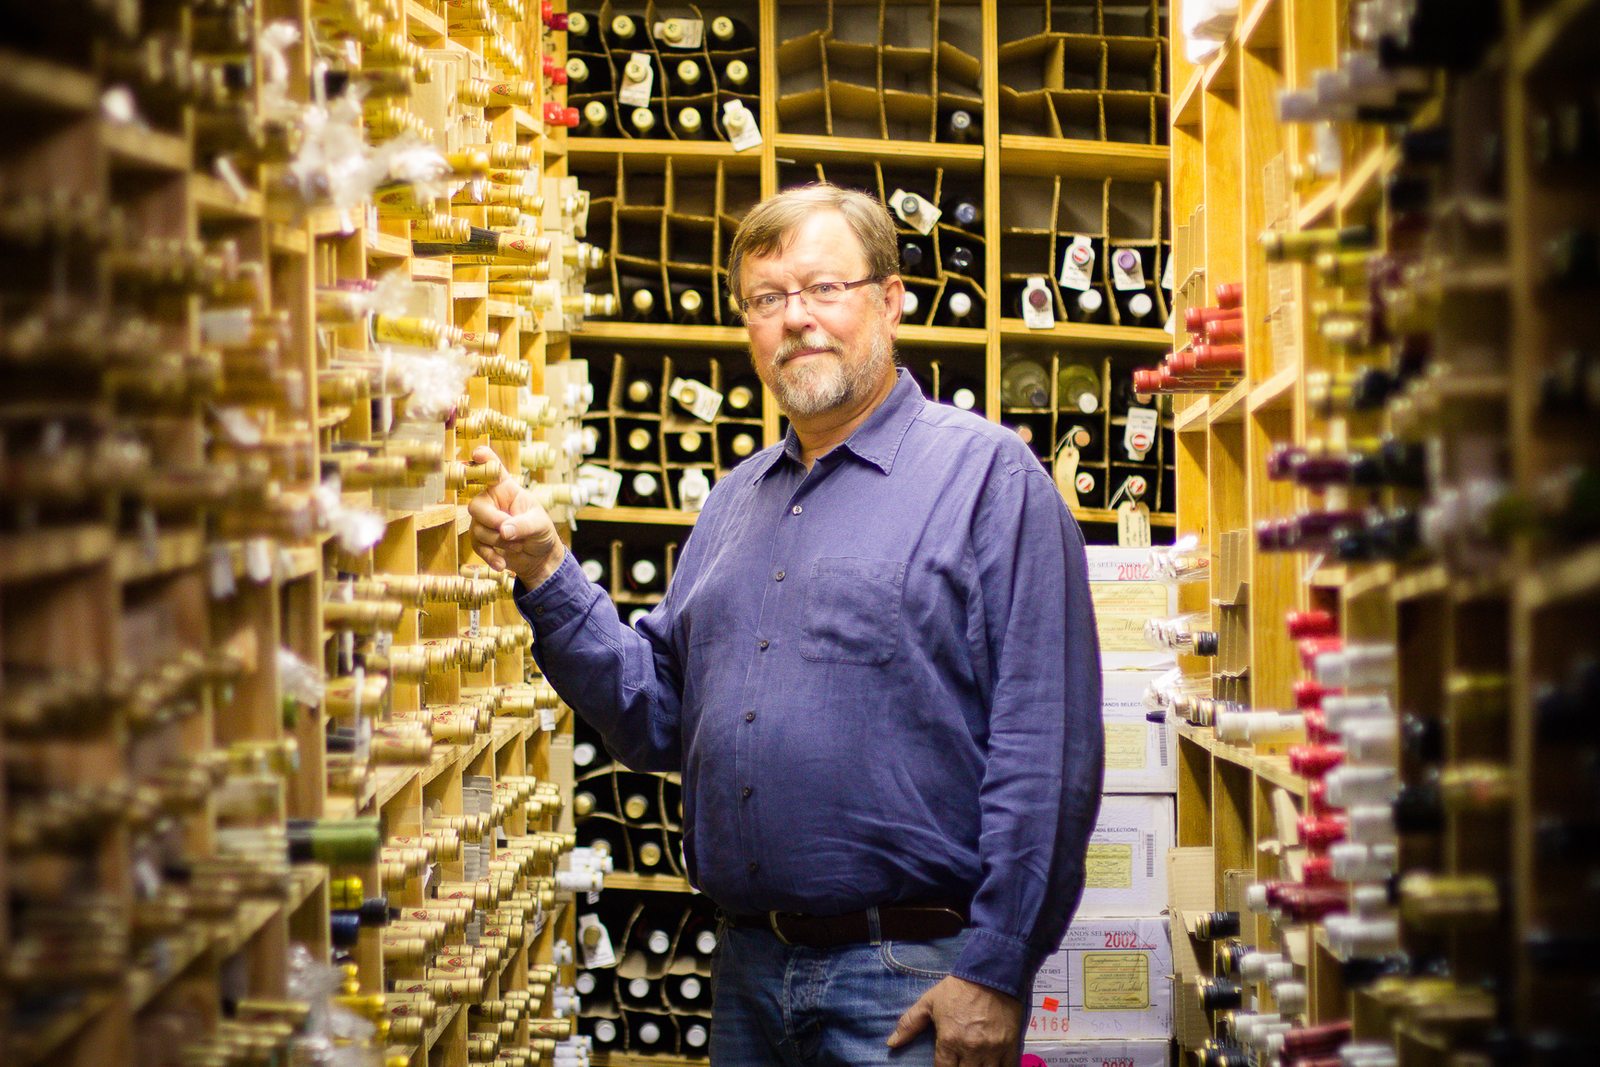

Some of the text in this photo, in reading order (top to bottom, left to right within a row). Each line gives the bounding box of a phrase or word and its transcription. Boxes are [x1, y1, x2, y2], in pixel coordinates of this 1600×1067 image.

[1117, 564, 1150, 581] 2002
[1104, 932, 1137, 949] 2002
[1030, 1015, 1069, 1032] 4168
